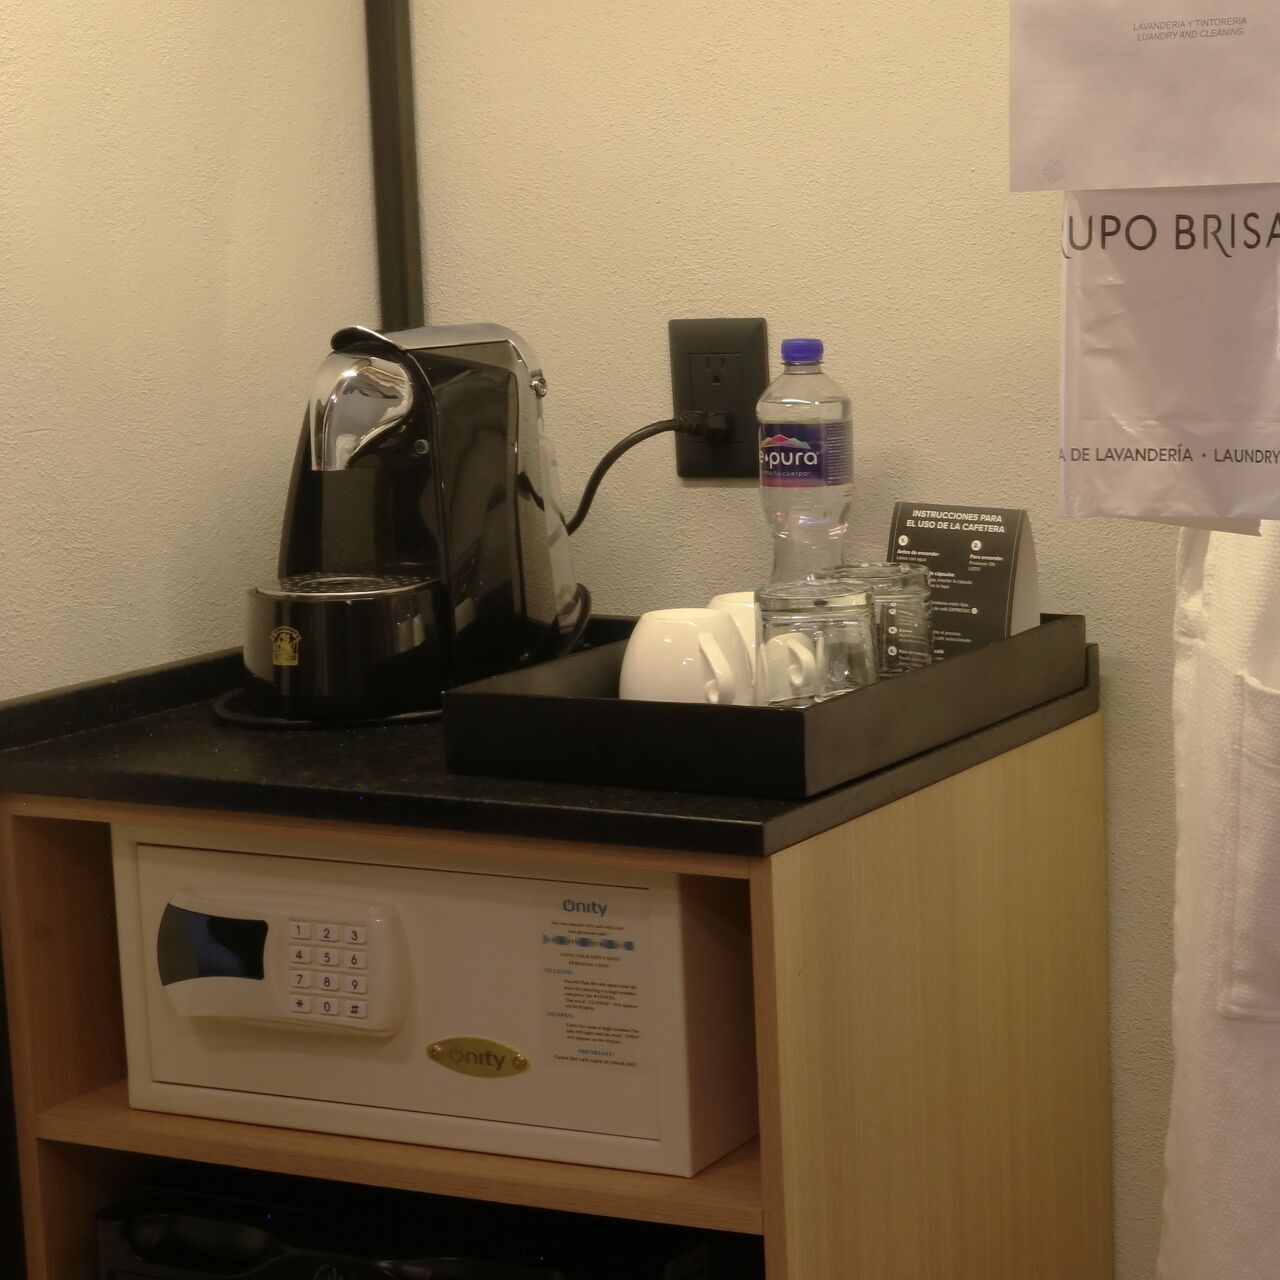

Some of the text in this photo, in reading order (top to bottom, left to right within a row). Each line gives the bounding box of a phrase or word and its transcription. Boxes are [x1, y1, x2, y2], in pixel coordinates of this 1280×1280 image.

[1187, 19, 1193, 27] Y
[1178, 30, 1198, 39] AND
[1199, 27, 1244, 38] CLEANING
[1062, 214, 1158, 260] UPO
[1070, 448, 1090, 462] DE
[1095, 443, 1194, 462] LAVANDERÍA
[1214, 449, 1280, 464] LAUNDRY
[912, 509, 1002, 523] INSTRUCCIONES PARA
[906, 519, 1005, 533] EL USO DE LA CAFETERA
[562, 898, 608, 918] Onity
[296, 925, 358, 941] 1 2 3
[295, 950, 358, 965] 4 5 6
[296, 974, 358, 990] 7 8 9
[323, 1001, 331, 1012] 0
[448, 1047, 506, 1071] Onity
